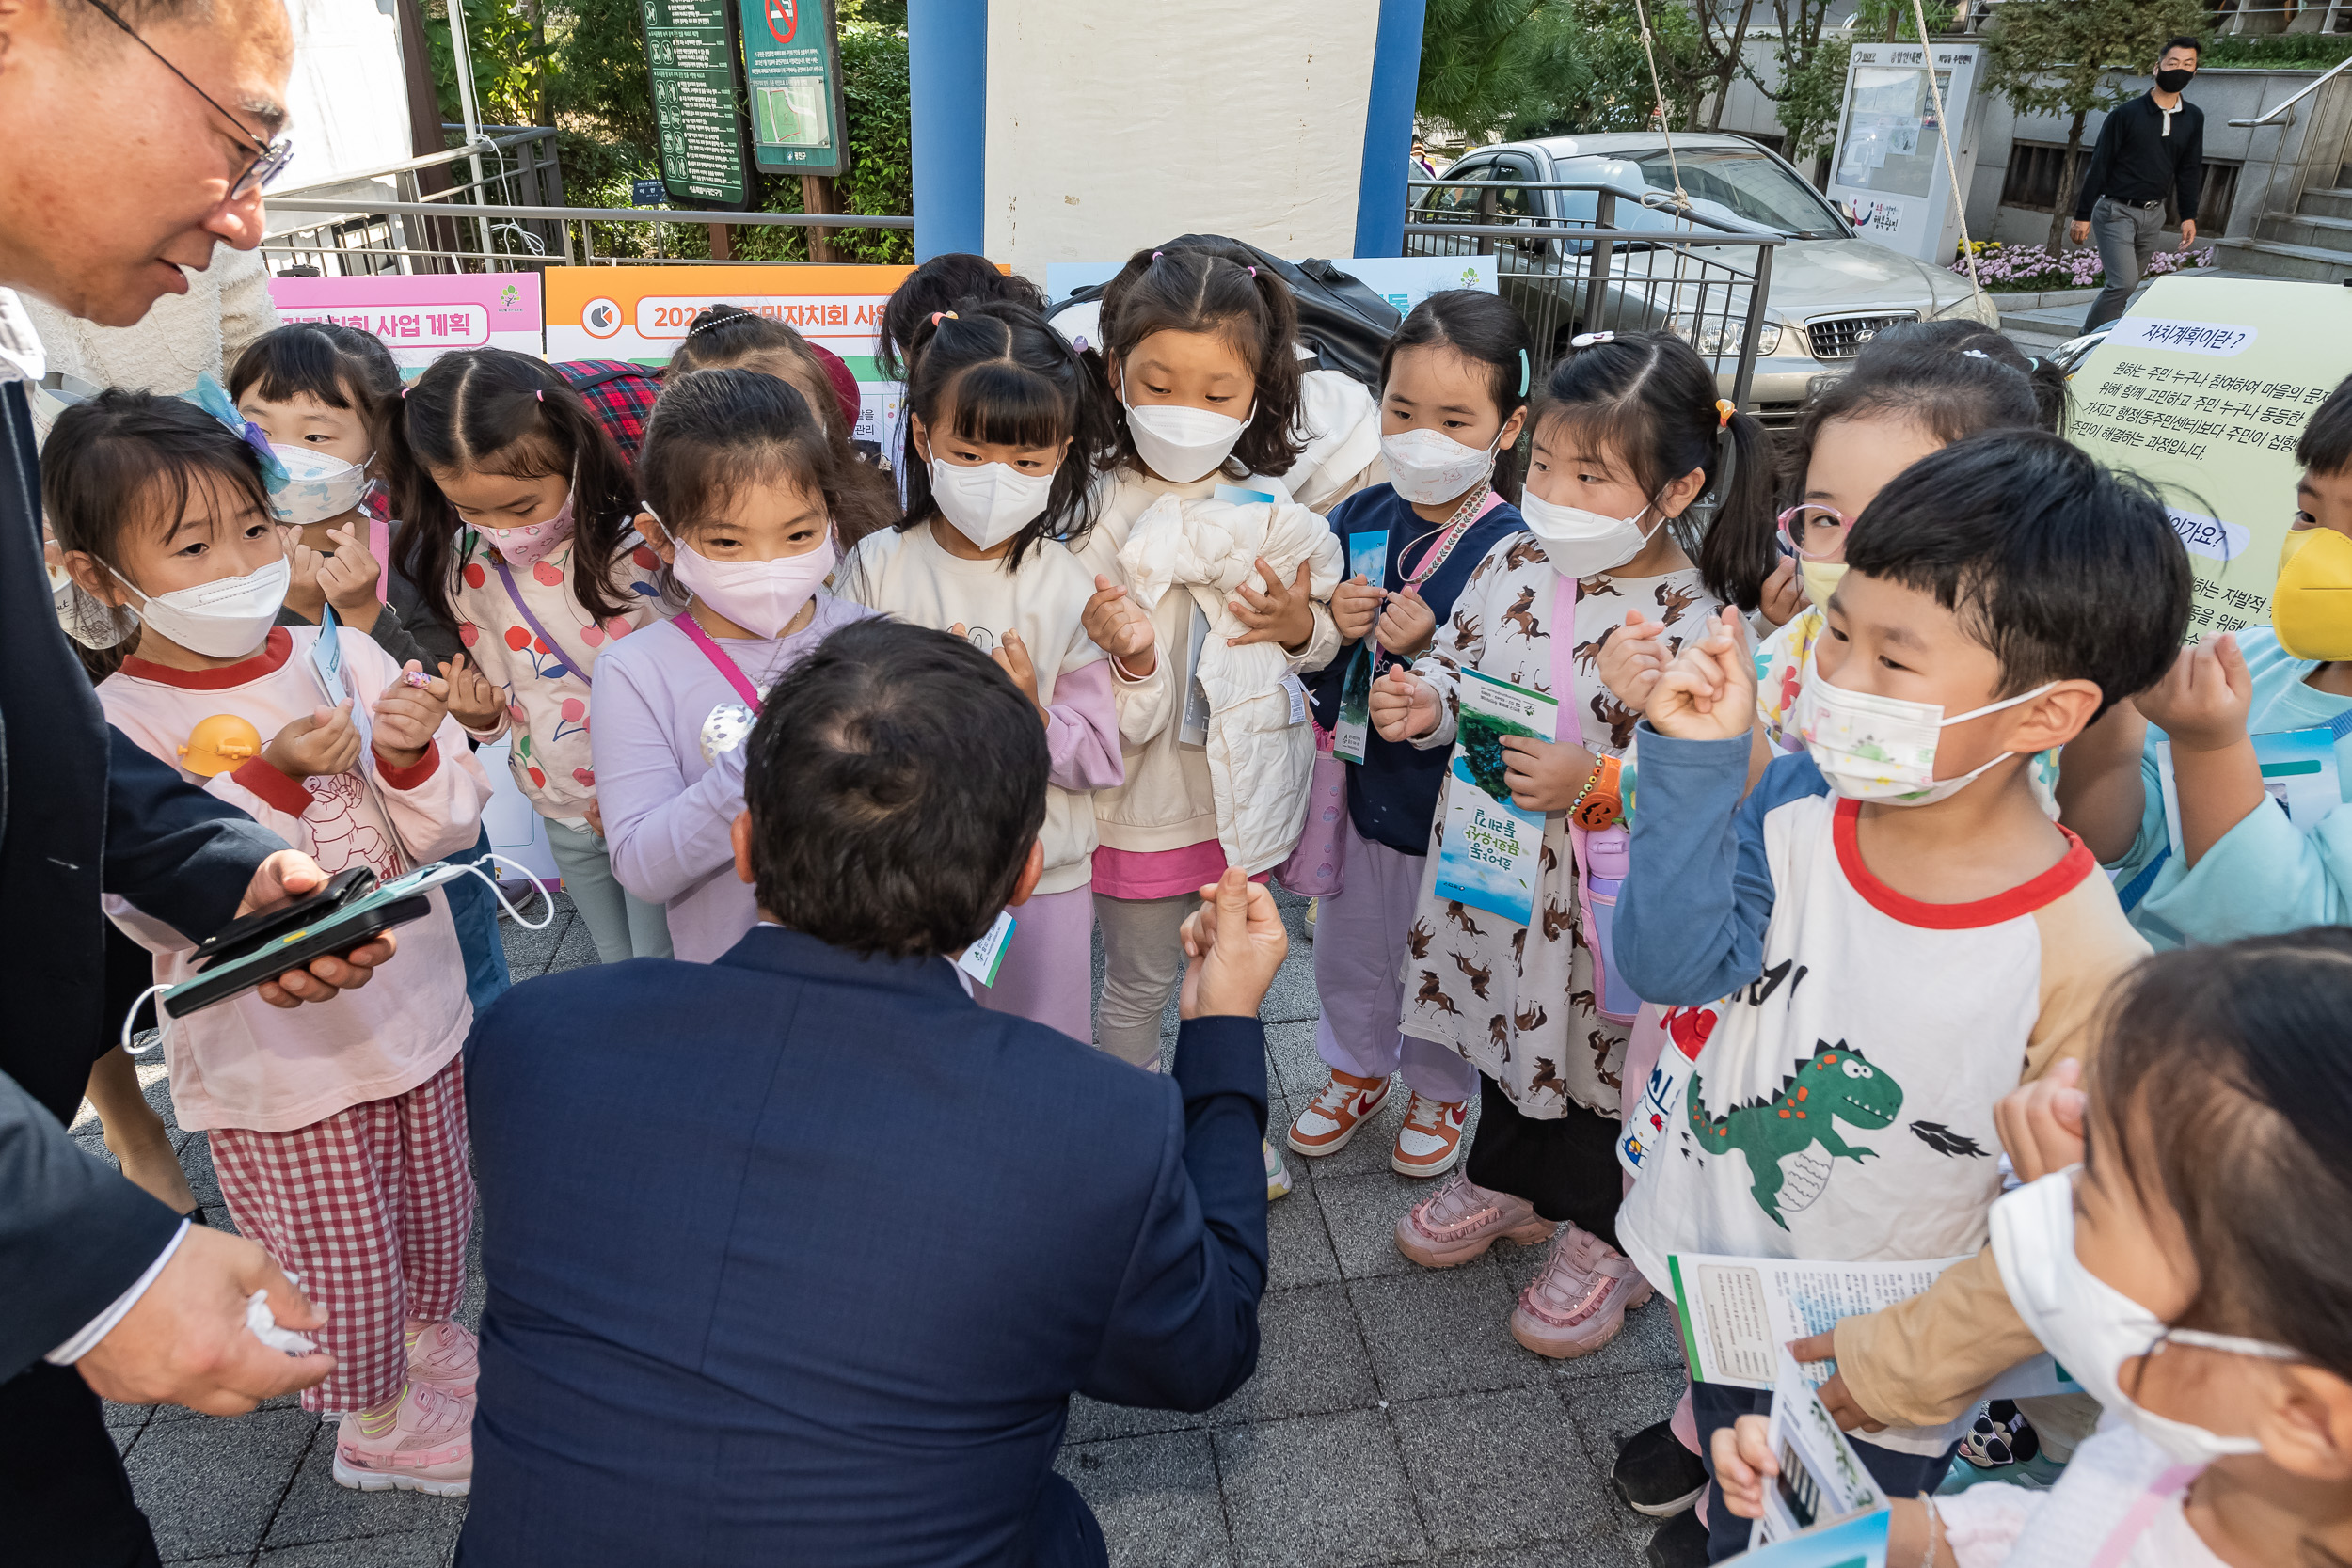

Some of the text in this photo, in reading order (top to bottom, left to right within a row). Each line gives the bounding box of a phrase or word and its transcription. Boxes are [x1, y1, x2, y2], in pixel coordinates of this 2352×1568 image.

[376, 314, 421, 338] 사업
[426, 313, 470, 337] 계획
[2142, 325, 2234, 349] 자치계획이란
[2113, 361, 2146, 378] 원하는
[2147, 366, 2173, 382] 주민
[2172, 370, 2209, 388] 누구나
[2208, 374, 2263, 395] 참여하여
[2261, 382, 2306, 402] 마을의
[2098, 381, 2123, 397] 위해
[2121, 384, 2148, 401] 함께
[2143, 388, 2192, 407] 고민하고
[2192, 395, 2221, 413] 주민
[2220, 400, 2262, 420] 누구나
[2259, 406, 2306, 427] 동등한
[2070, 420, 2207, 461] 주민이 해결하는 과정입니다.
[2084, 401, 2117, 418] 가지고
[2115, 405, 2227, 439] 행정(동주민센터)보다
[2226, 425, 2269, 448] 주민이
[2192, 576, 2219, 599] 하는
[2220, 588, 2267, 614] 자발적
[1474, 808, 1516, 838] 둘레길
[1465, 825, 1520, 856] 문화유산
[1470, 842, 1512, 871] 화양동
